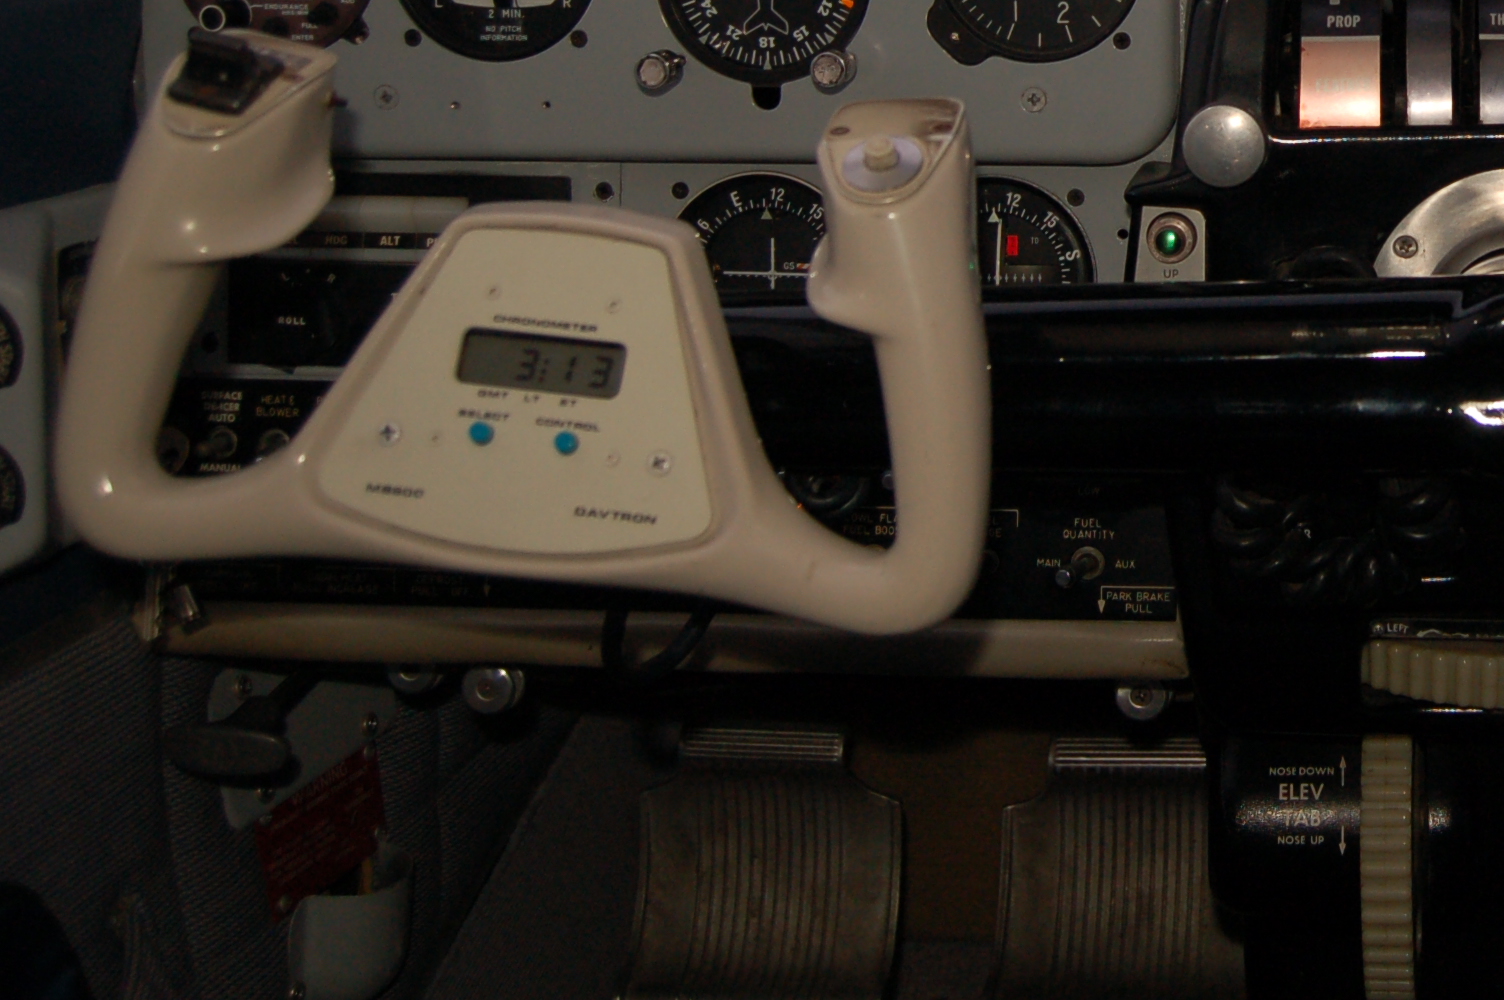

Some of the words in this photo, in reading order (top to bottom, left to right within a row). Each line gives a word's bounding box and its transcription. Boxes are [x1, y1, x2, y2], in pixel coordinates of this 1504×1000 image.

[1056, 1, 1070, 24] 2
[1326, 15, 1361, 28] PROP
[730, 190, 743, 208] E
[770, 187, 785, 202] 12
[380, 235, 401, 246] ALT
[1163, 269, 1179, 278] UP
[278, 316, 306, 326] ROLL
[493, 314, 598, 333] CHRONOMETER
[515, 348, 615, 389] 3:13
[256, 406, 300, 417] BLOWER
[208, 413, 236, 422] AUTO
[535, 416, 600, 433] CONTROL
[574, 505, 658, 525] DAVTRON
[1074, 517, 1101, 528] FUEL
[1063, 529, 1115, 540] QUANTITY
[1036, 558, 1061, 568] MAIN
[1115, 559, 1136, 569] AUX
[1106, 591, 1132, 601] PARK
[1136, 592, 1170, 602] BRAKE
[1124, 603, 1153, 613] PULL
[1269, 766, 1297, 776] NOSE
[1299, 766, 1335, 776] DOWN
[1278, 782, 1325, 801] ELEV
[1284, 809, 1322, 828] TAB
[1277, 835, 1305, 845] NOSE
[1310, 835, 1325, 845] UP
